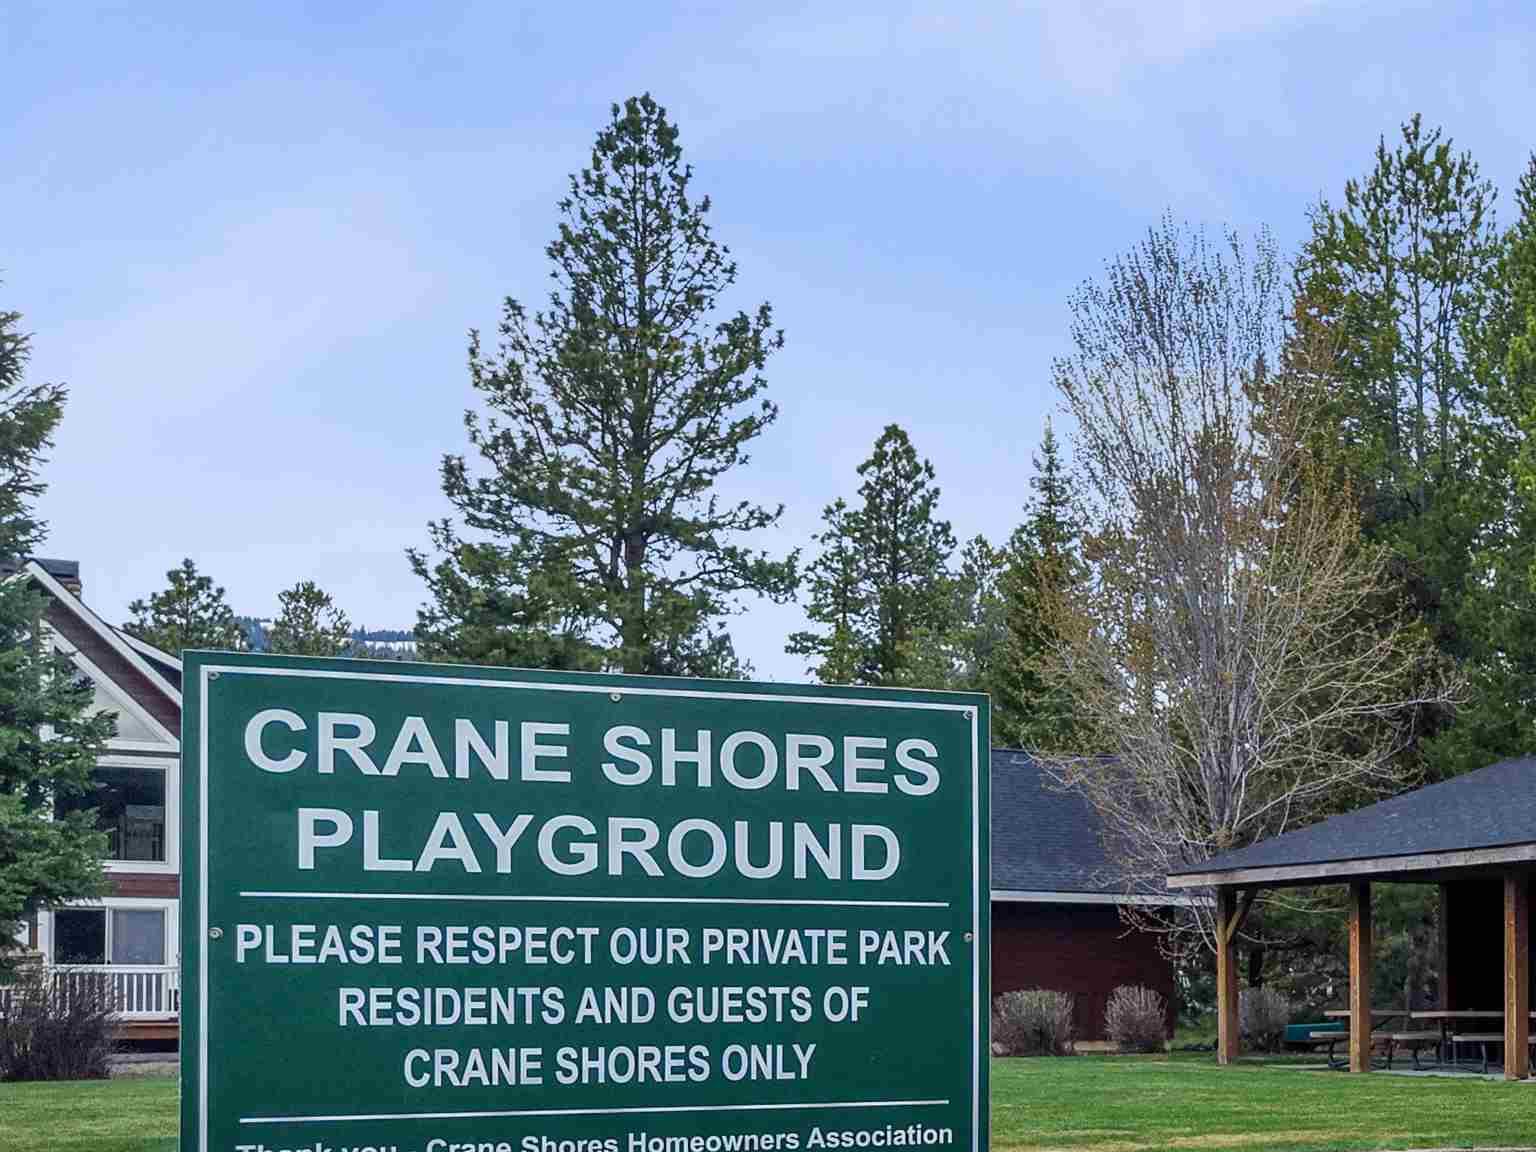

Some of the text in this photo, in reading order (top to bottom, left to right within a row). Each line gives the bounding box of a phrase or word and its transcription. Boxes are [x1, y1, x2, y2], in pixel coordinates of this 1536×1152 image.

[245, 709, 939, 795] CRANE SHORES
[298, 808, 899, 880] PLAYGROUND
[237, 925, 950, 964] PLEASE RESPECT OUR PRIVATE PARK
[340, 986, 869, 1025] RESIDENTS AND GUESTS OF
[405, 1044, 816, 1087] CRANE SHORES ONLY
[807, 1124, 952, 1148] Association
